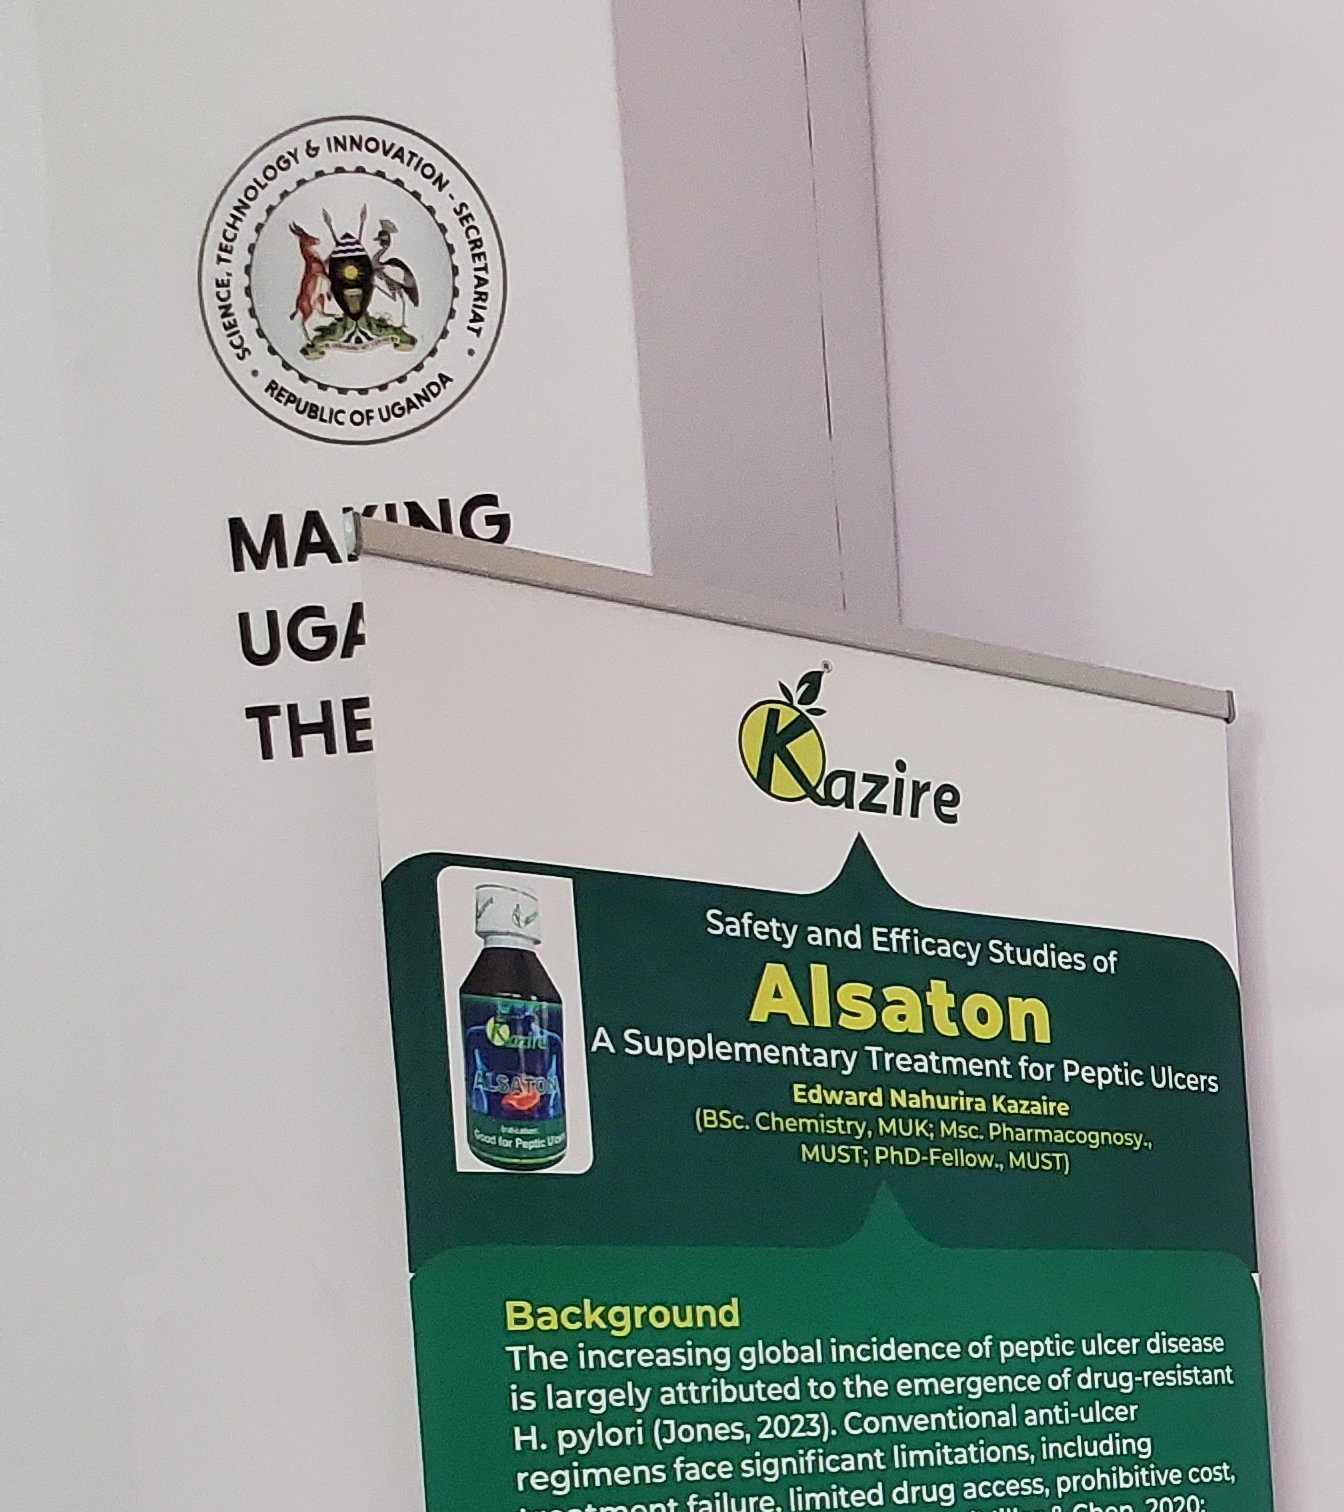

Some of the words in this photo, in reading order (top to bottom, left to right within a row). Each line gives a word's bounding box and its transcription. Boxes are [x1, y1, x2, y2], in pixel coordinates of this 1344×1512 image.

[306, 140, 320, 158] &
[327, 135, 450, 193] INNOVATION
[217, 148, 300, 266] TECHNOLOGY
[454, 201, 488, 338] SECRETARIAT
[214, 268, 252, 361] SCIENCE,
[263, 379, 346, 427] REPUBLIC
[350, 409, 374, 426] OF
[378, 373, 454, 423] UGANDA
[228, 494, 512, 572] MANG
[738, 699, 962, 824] Kazire
[707, 909, 798, 948] Safety
[808, 924, 861, 949] and
[873, 927, 981, 966] Efficacy
[989, 940, 1086, 970] Studies
[1093, 951, 1118, 974] of
[749, 963, 1050, 1043] Alsaton
[591, 1027, 615, 1053] A
[624, 1029, 857, 1075] Supplementary
[865, 1046, 1012, 1078] Treatment
[1018, 1056, 1054, 1081] for
[1063, 1060, 1144, 1090] Peptic
[1151, 1066, 1218, 1092] Ulcers
[506, 1298, 739, 1336] Background
